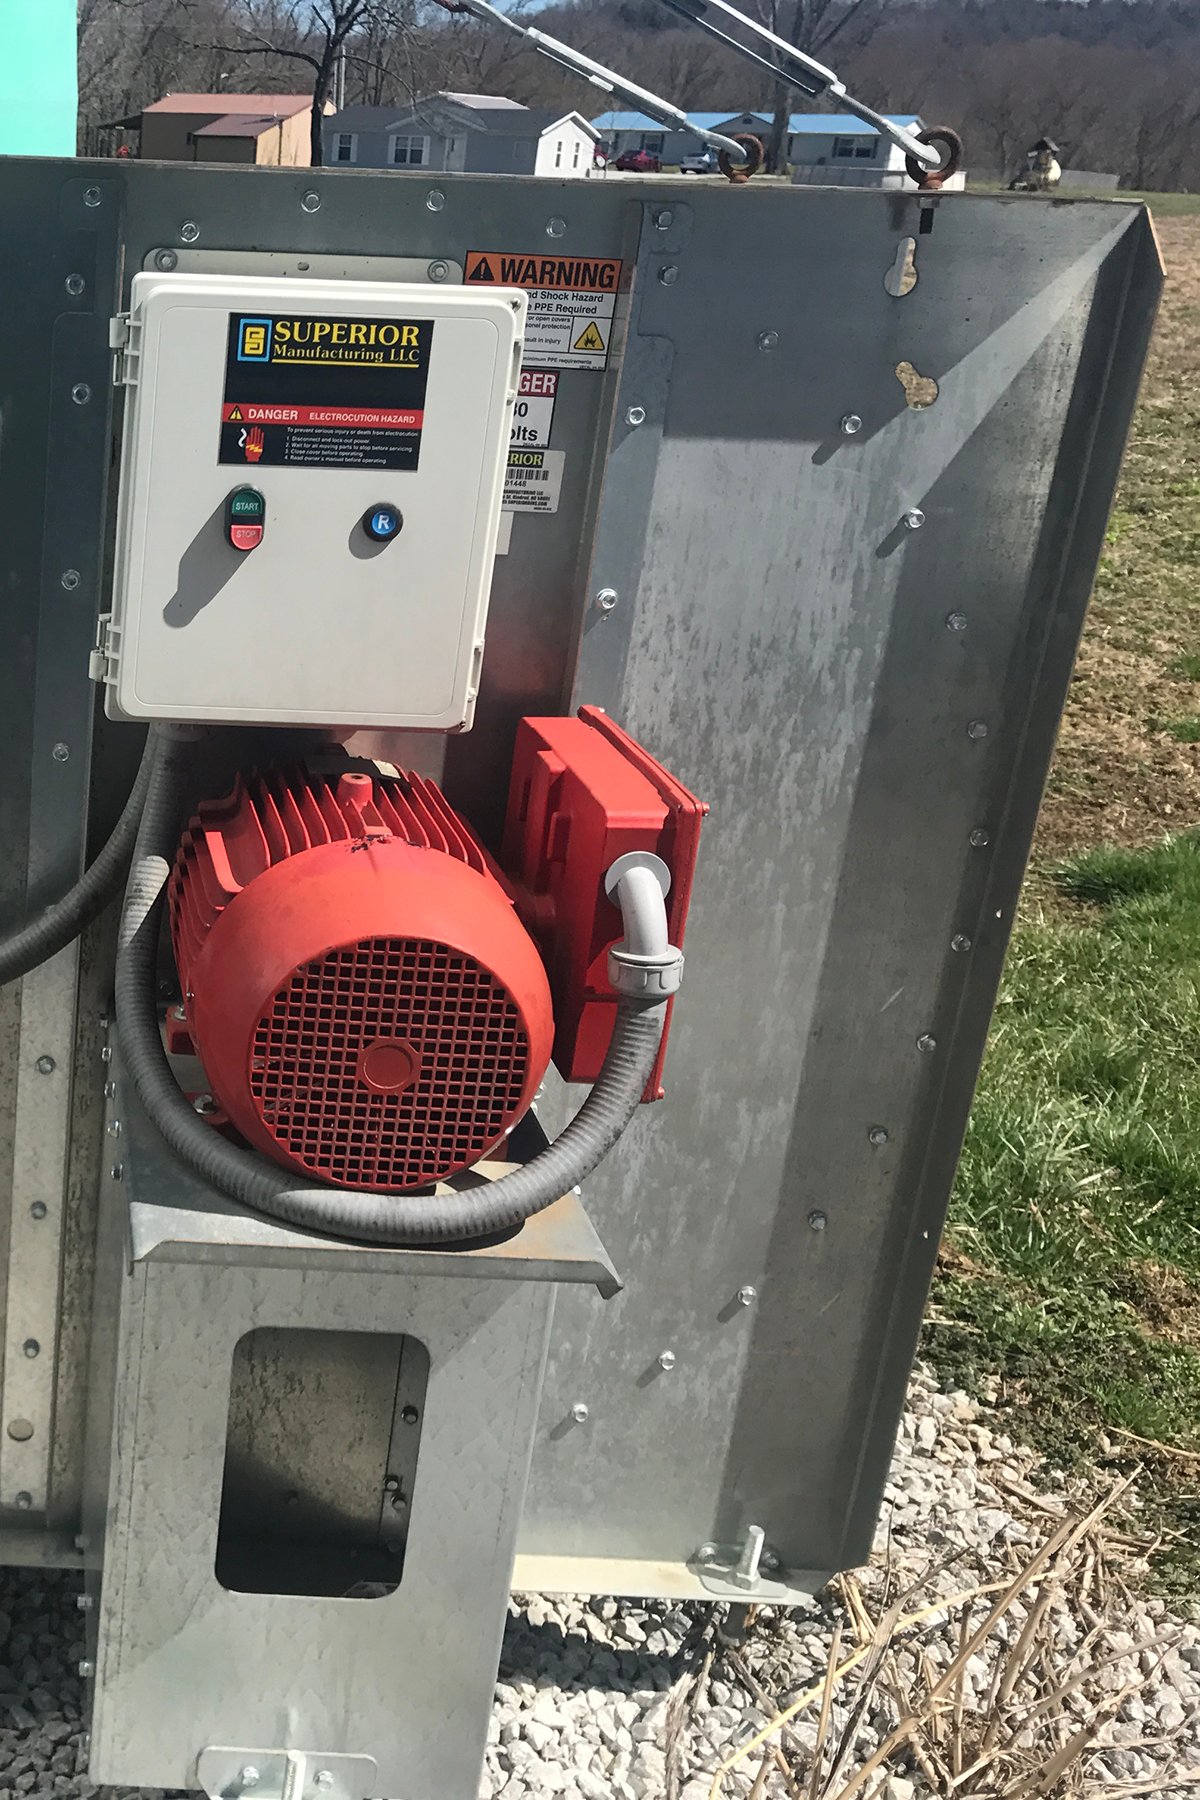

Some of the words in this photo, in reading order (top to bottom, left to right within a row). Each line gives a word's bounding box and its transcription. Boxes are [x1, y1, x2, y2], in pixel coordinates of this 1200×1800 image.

[501, 258, 615, 288] WARNING
[540, 290, 569, 300] Shock
[572, 293, 604, 303] Hazard
[534, 302, 554, 312] PPE
[556, 304, 597, 314] Required
[274, 320, 420, 346] SUPERIOR
[273, 344, 384, 362] Manufacturing
[390, 348, 420, 362] LLC
[519, 372, 556, 394] GER
[248, 408, 298, 420] DANGER
[309, 412, 379, 422] ELECTROCUTION
[380, 415, 416, 424] HAZARD
[236, 502, 258, 510] START
[378, 515, 390, 530] R
[236, 530, 256, 538] STOP
